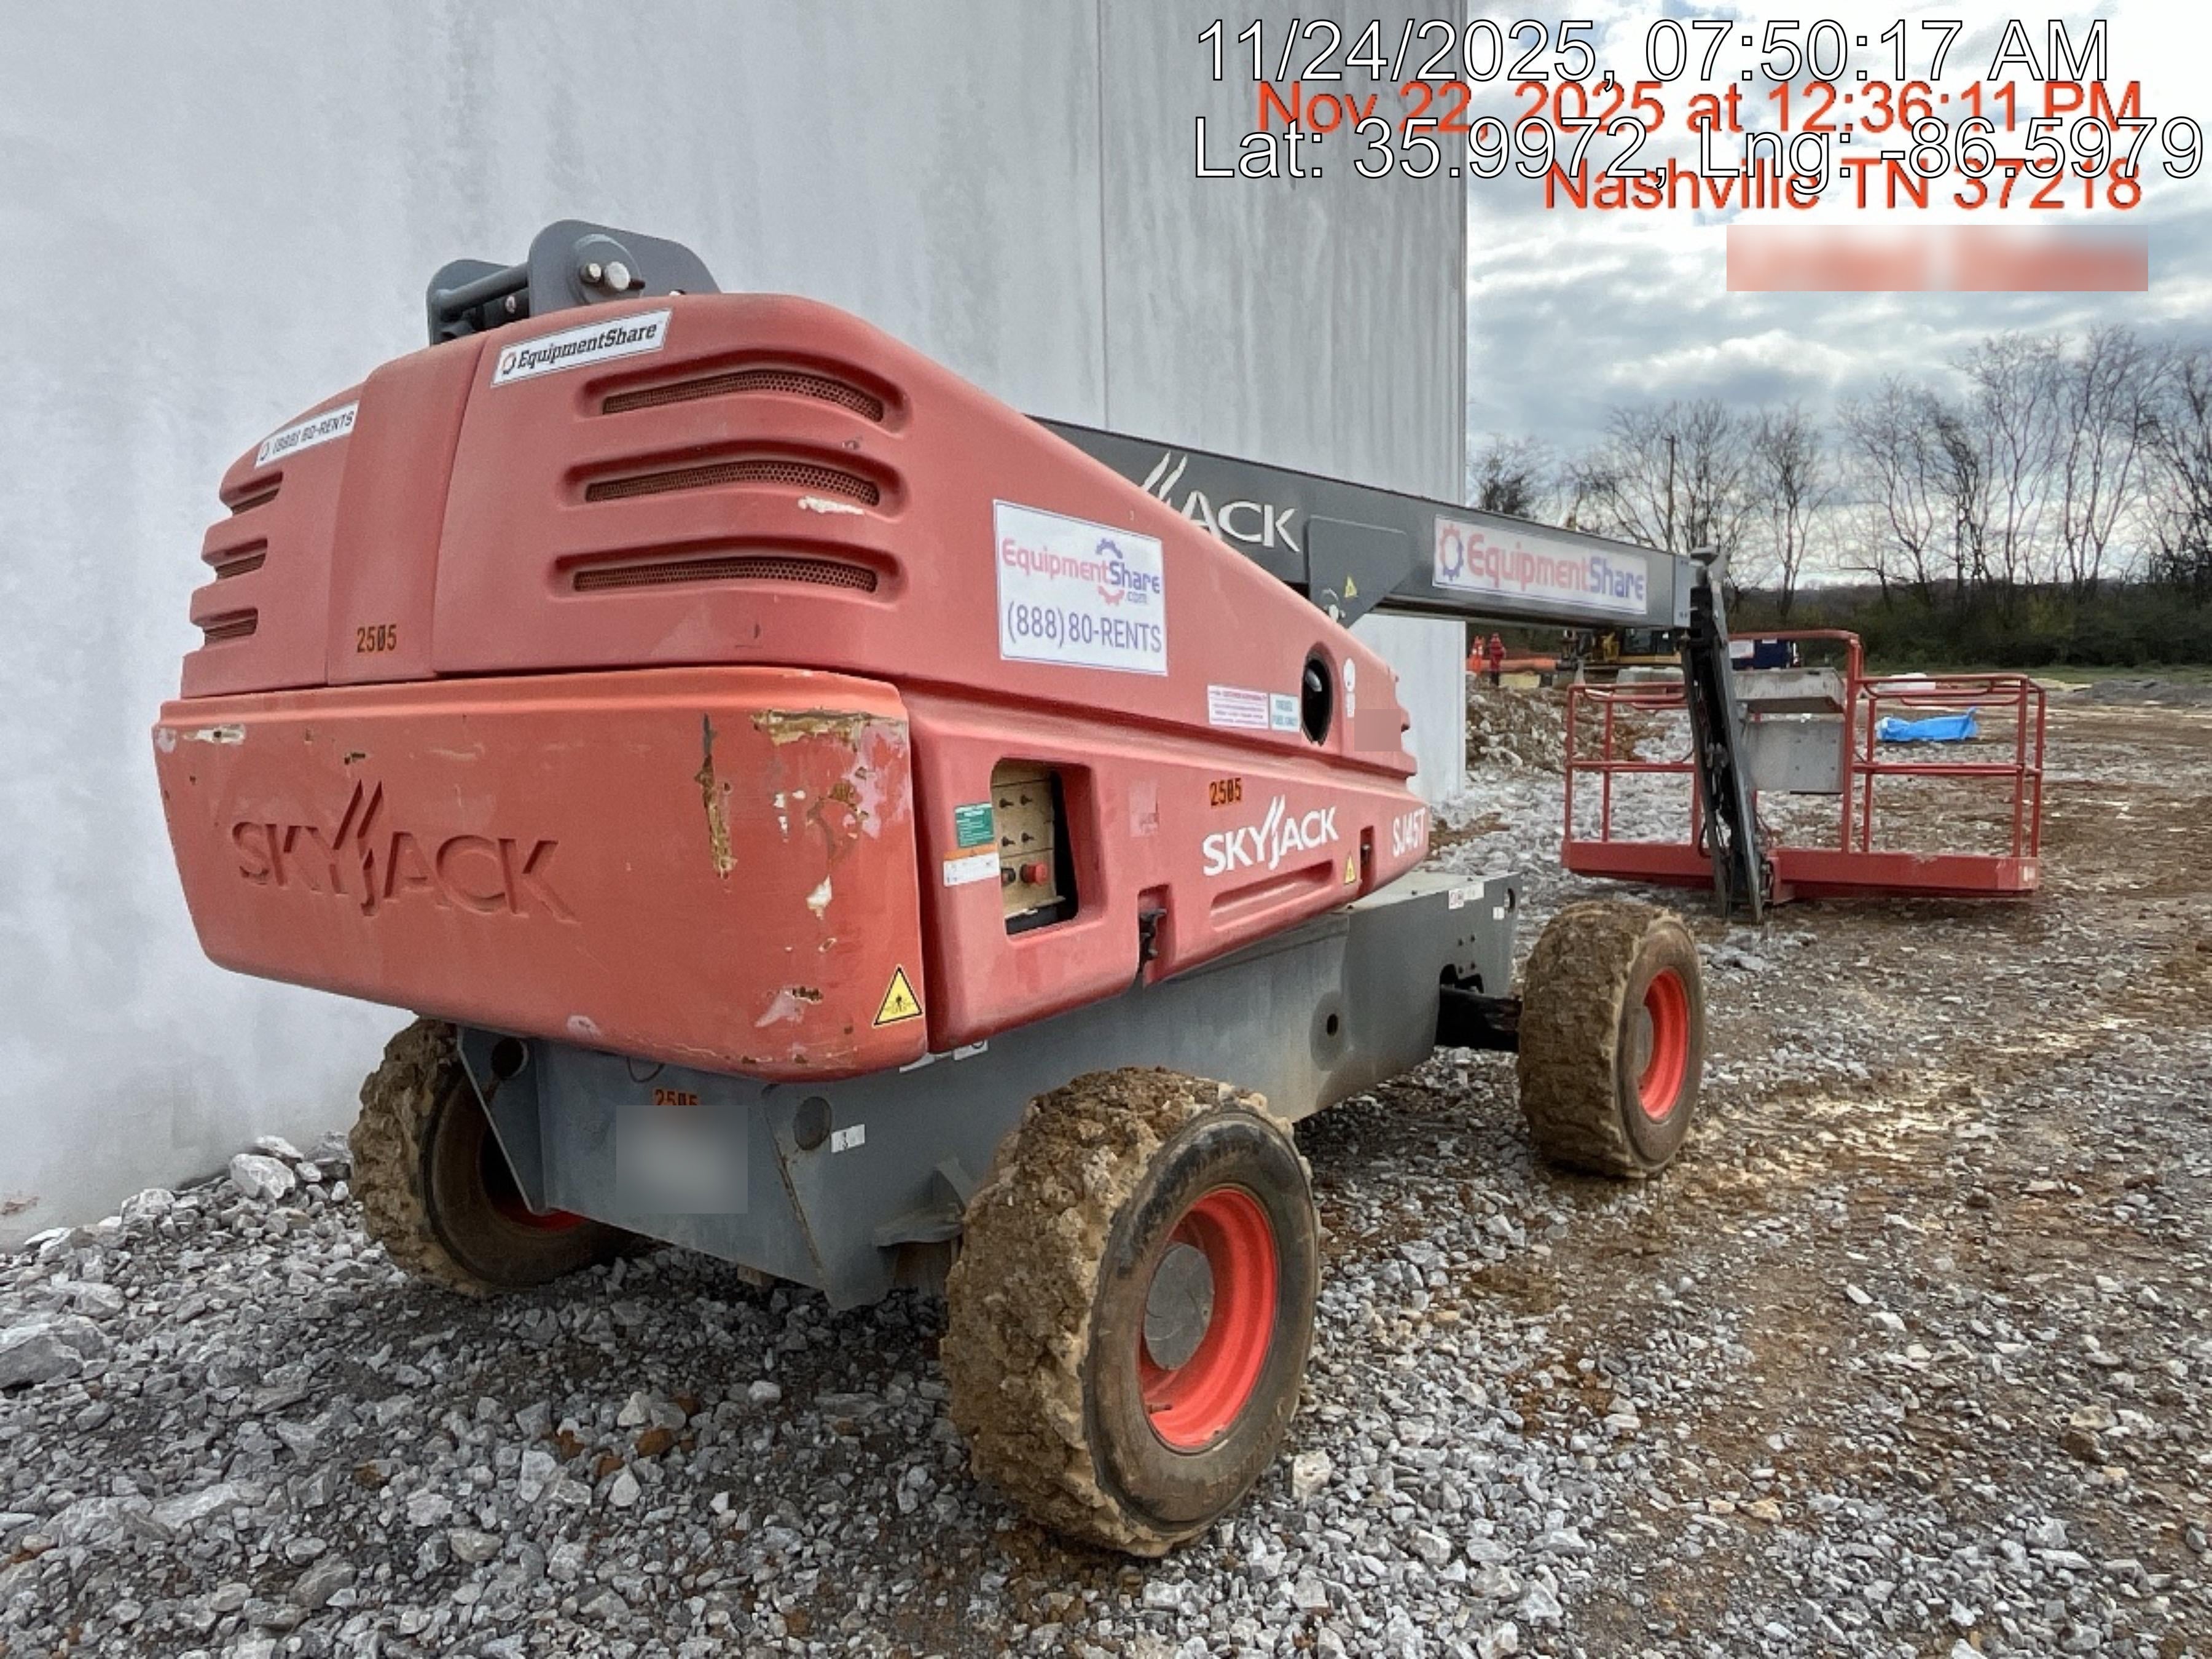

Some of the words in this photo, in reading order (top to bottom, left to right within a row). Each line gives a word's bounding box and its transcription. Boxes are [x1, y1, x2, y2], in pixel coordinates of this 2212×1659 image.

[517, 323, 657, 369] EquipmentShare
[1002, 538, 1160, 594] EquipmentShare
[1467, 533, 1643, 600] EquipmentShare
[357, 624, 397, 653] 2505
[1209, 777, 1242, 806] 2505
[231, 778, 577, 924] SKYJACK
[1202, 794, 1339, 876] SKYJACK
